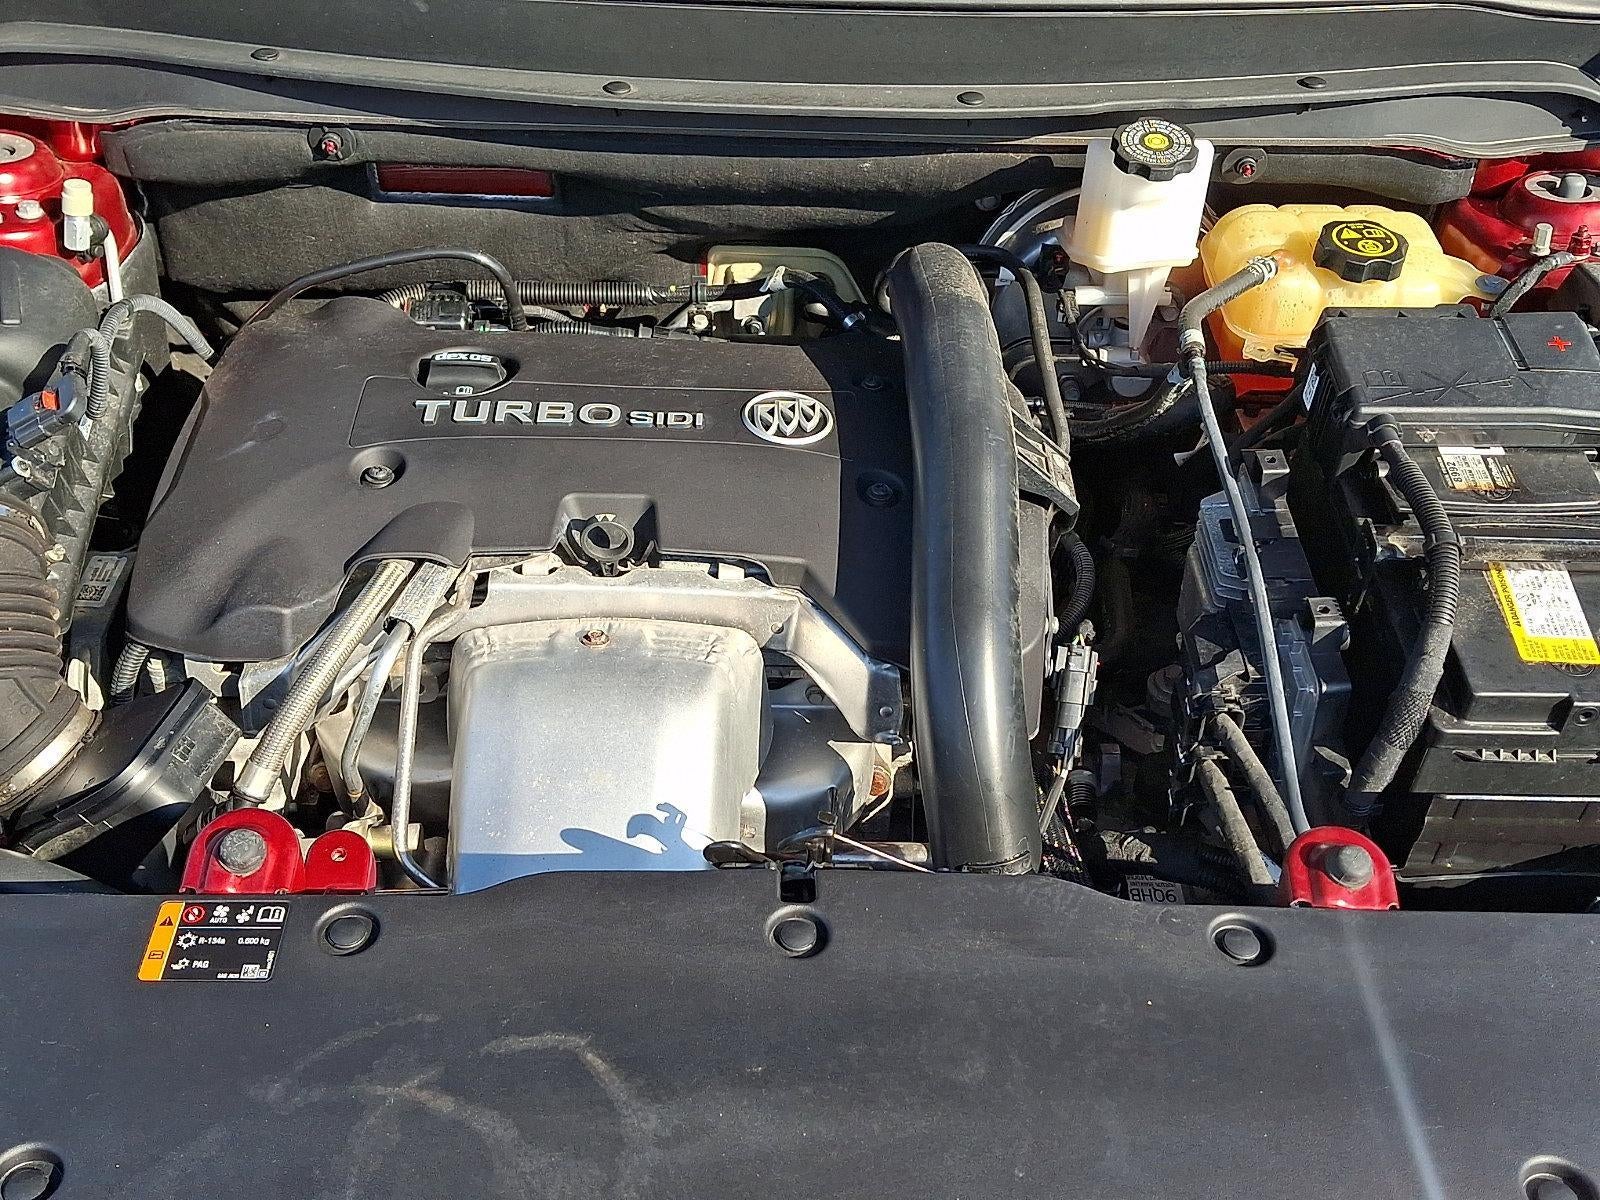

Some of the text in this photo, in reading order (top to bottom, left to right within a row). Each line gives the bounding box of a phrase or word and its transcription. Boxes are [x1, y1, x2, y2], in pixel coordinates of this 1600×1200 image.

[434, 352, 492, 362] dexos
[415, 400, 704, 429] TURBO SIDI
[198, 936, 226, 945] R-134a
[260, 937, 271, 946] kg
[192, 960, 210, 969] PAG
